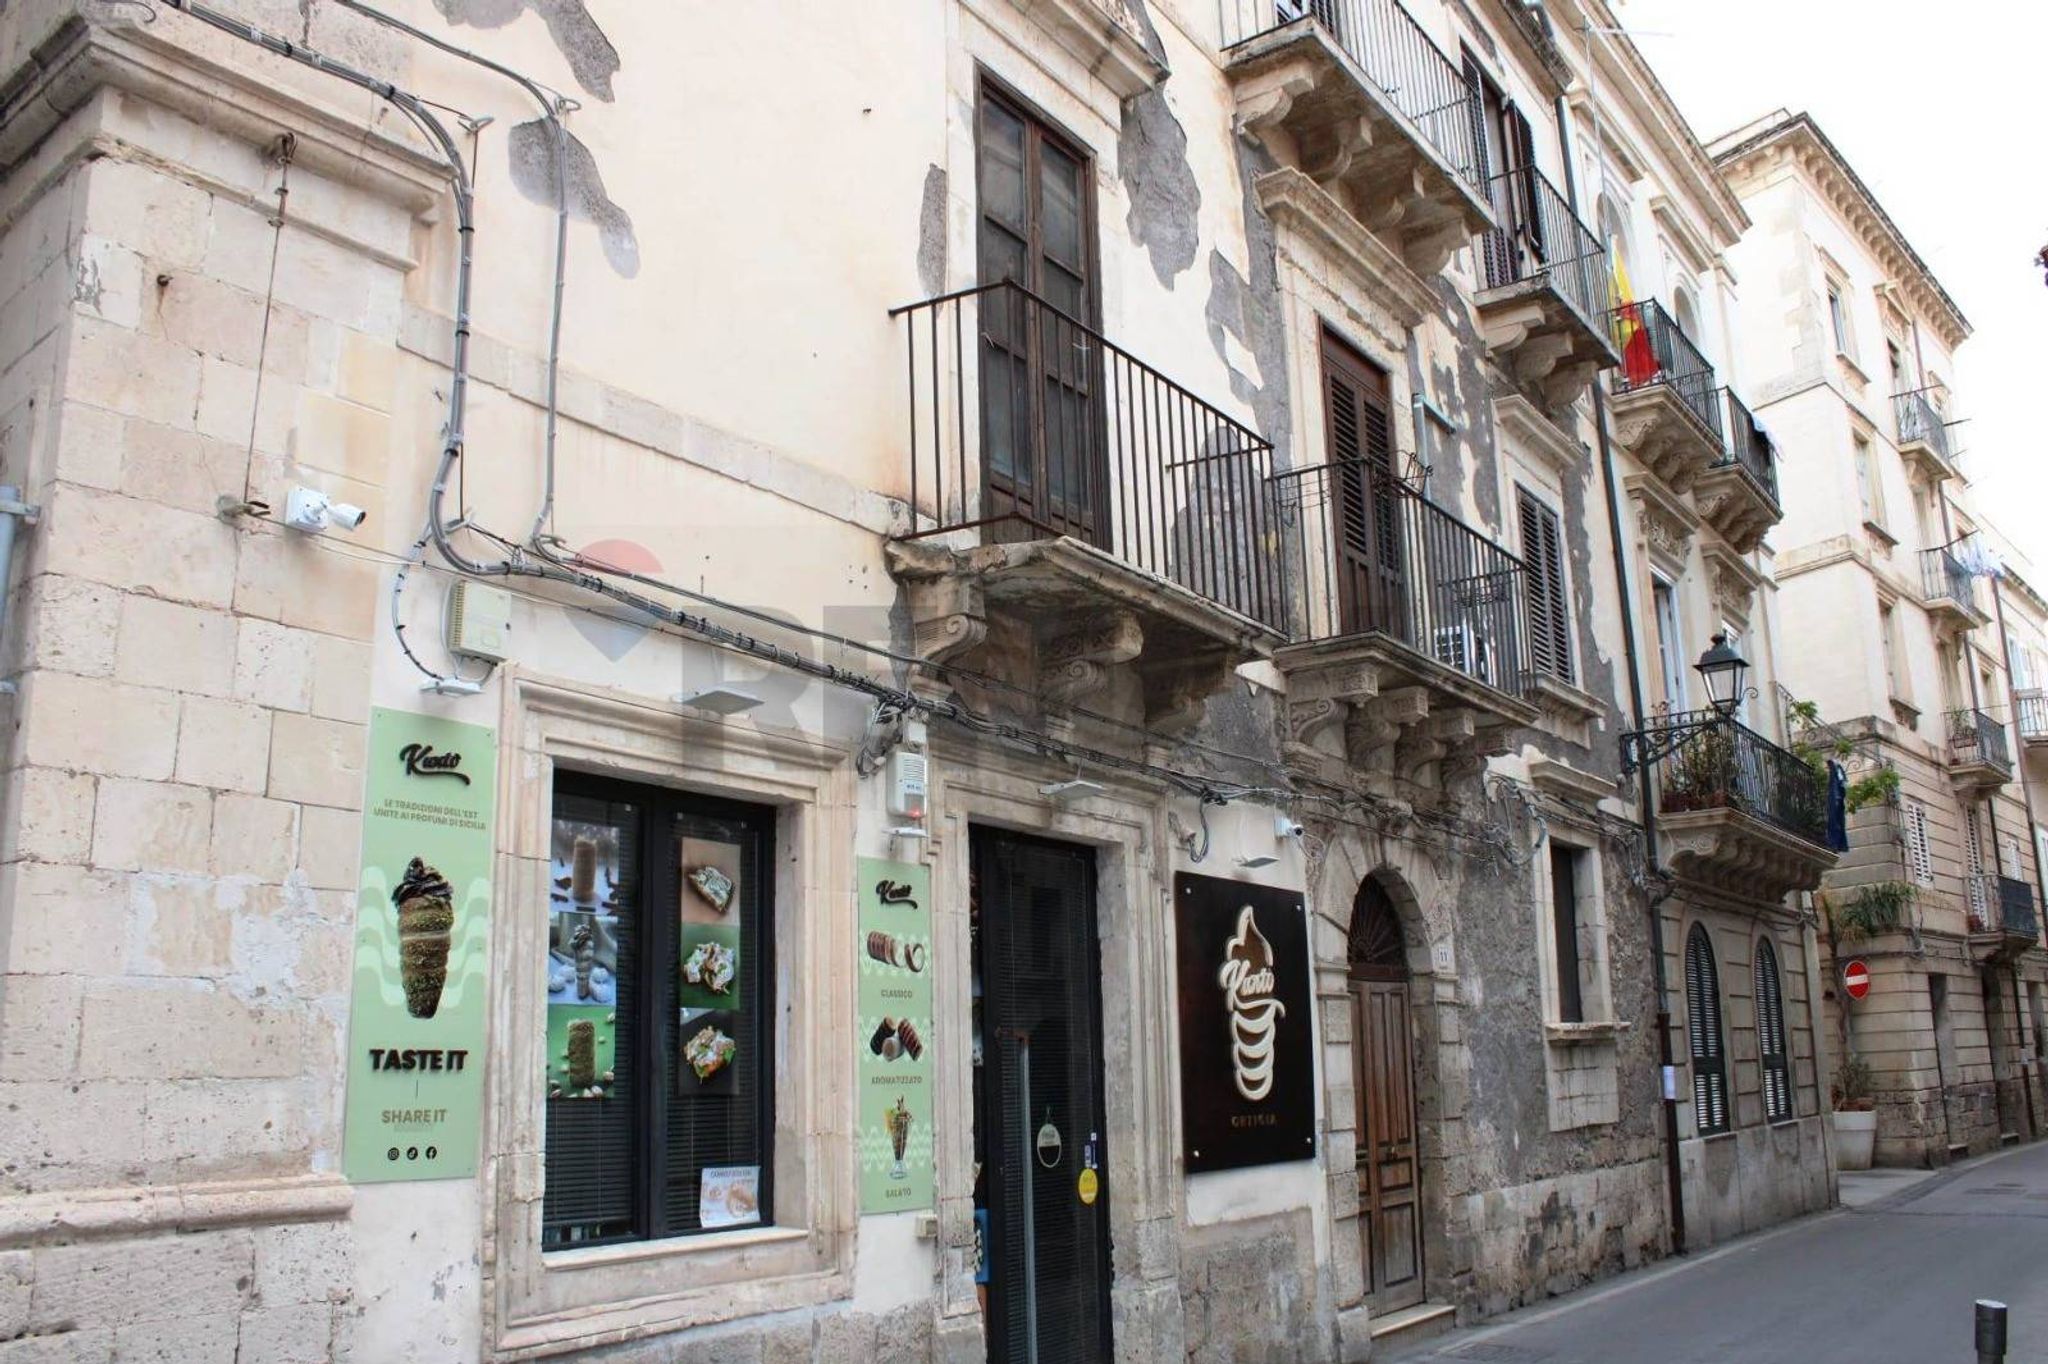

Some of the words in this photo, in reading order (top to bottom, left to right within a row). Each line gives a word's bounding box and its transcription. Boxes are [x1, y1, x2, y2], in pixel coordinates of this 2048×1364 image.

[373, 807, 399, 820] UNITE
[401, 811, 410, 820] AI
[411, 812, 448, 826] PROFUMI
[449, 818, 458, 828] DI
[459, 819, 487, 831] SICILIA
[384, 798, 393, 808] LE
[395, 799, 443, 815] TRADIZIONI
[444, 806, 479, 819] DELL'EST
[880, 988, 913, 999] CLASSICO
[369, 1048, 442, 1072] TASTE
[446, 1048, 469, 1072] IT
[381, 1110, 431, 1123] SHARE
[434, 1109, 447, 1123] IT
